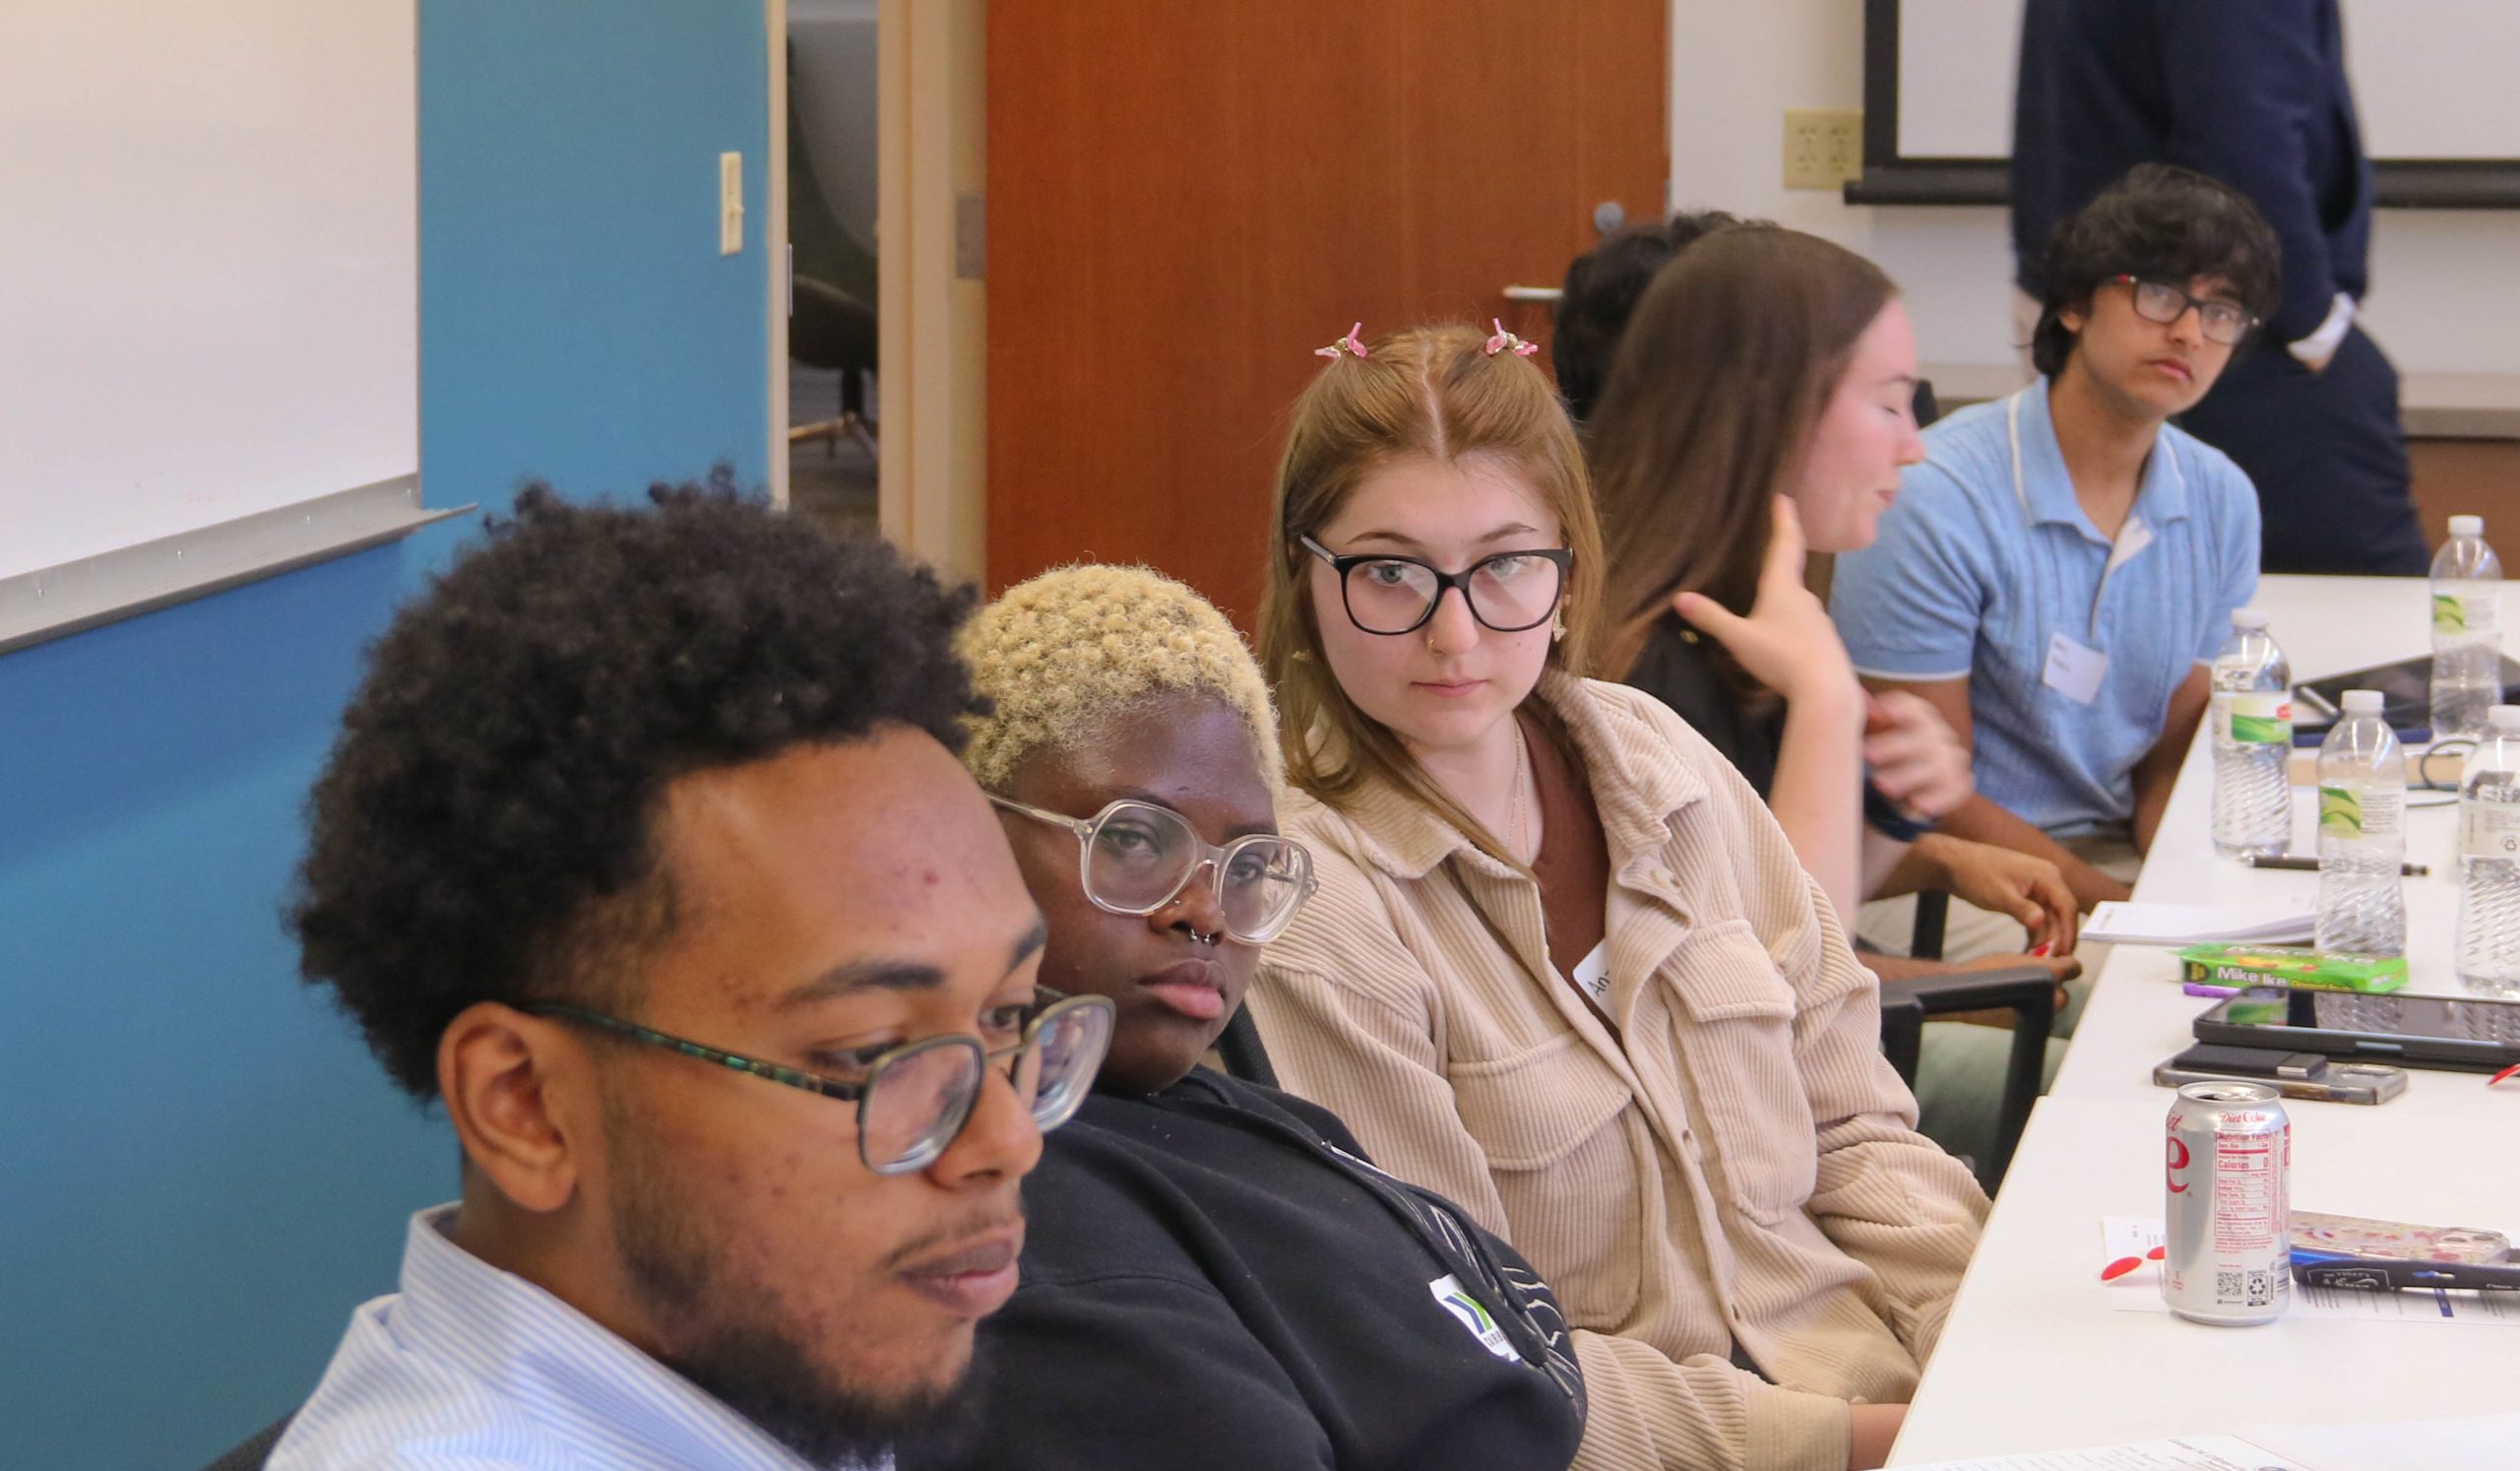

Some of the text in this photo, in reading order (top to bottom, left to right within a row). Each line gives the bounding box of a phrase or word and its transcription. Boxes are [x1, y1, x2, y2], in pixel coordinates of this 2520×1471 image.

[2218, 967, 2258, 982] Mike
[2263, 972, 2287, 986] Ike
[2219, 1111, 2240, 1123] Diet
[2218, 1160, 2250, 1169] Calories
